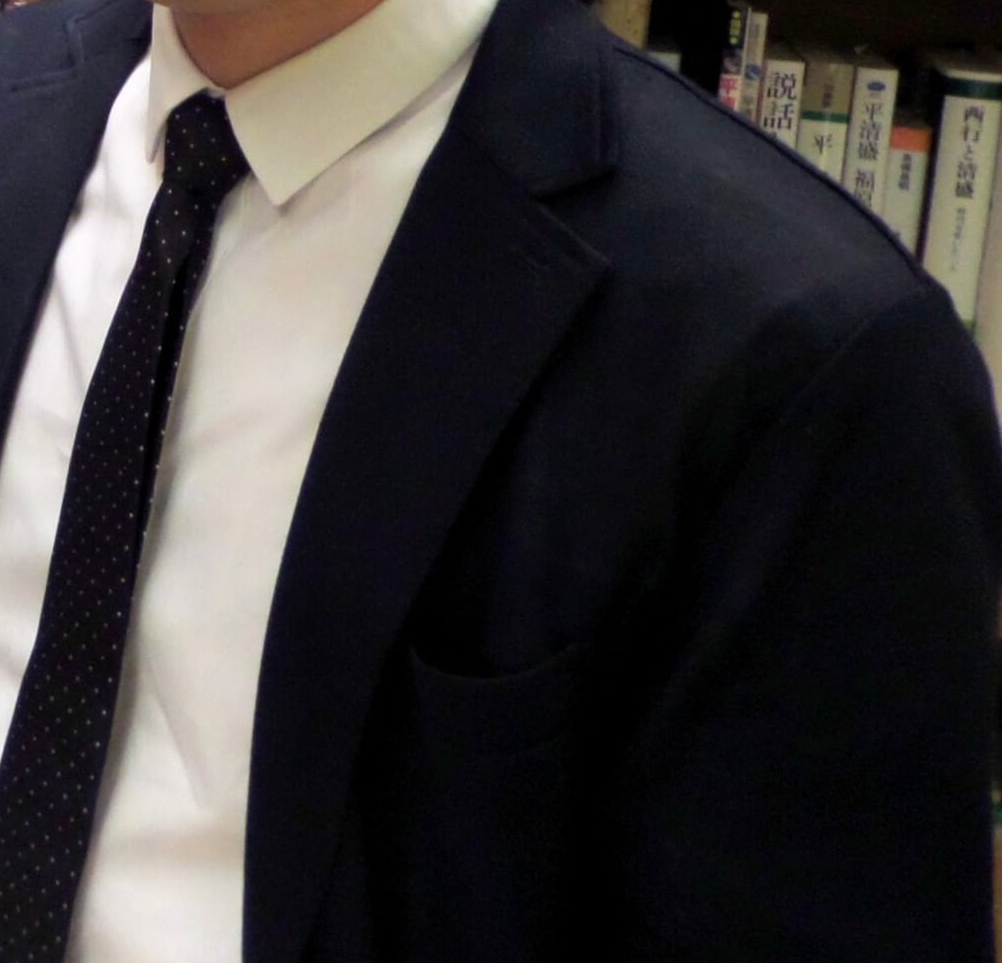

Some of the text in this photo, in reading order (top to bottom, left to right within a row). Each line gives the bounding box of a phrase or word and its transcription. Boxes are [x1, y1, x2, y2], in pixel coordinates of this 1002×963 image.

[764, 71, 798, 131] 説話
[856, 103, 883, 161] 平清盛
[954, 106, 985, 200] 西行と清盛
